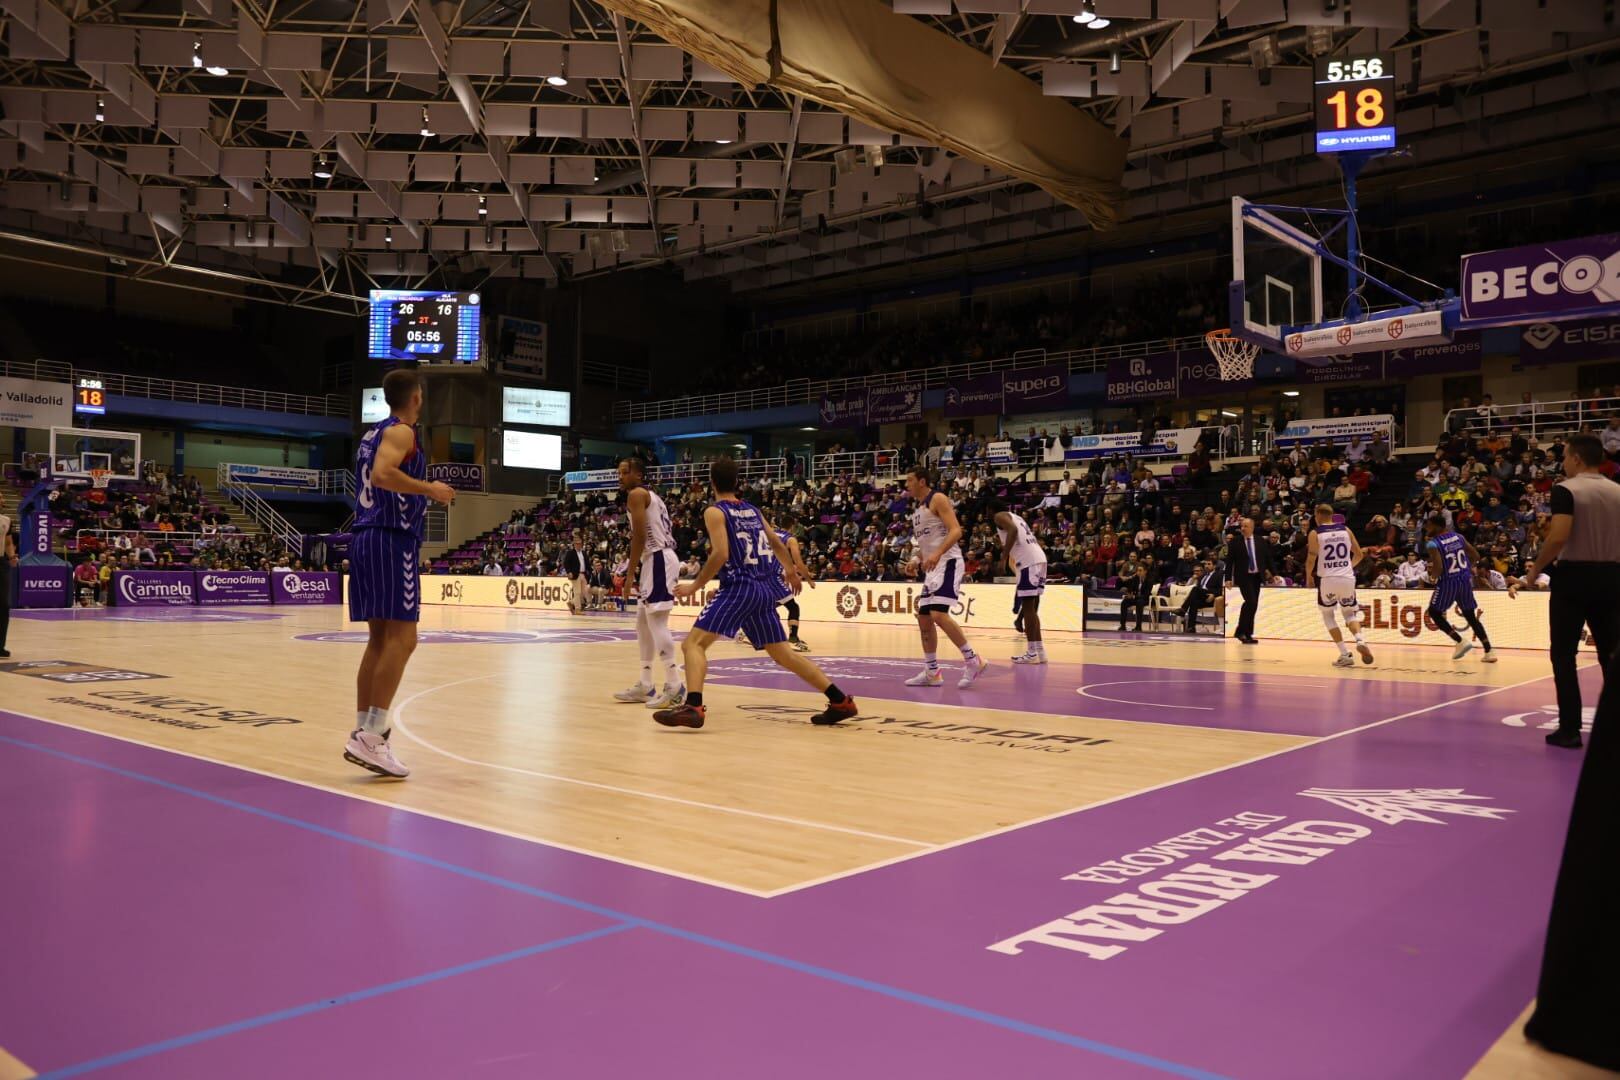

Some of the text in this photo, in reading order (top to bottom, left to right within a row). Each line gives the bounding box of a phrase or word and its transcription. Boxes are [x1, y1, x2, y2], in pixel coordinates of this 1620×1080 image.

[1327, 58, 1383, 81] 5:56
[1326, 88, 1384, 128] 18
[1340, 134, 1391, 144] HYUNDAI
[399, 303, 414, 315] 26
[437, 304, 452, 315] 16
[407, 331, 440, 342] 05:56
[408, 344, 416, 352] 4
[432, 344, 440, 353] 3
[1005, 375, 1061, 394] supera
[1108, 376, 1175, 395] RBHGlobal
[6, 391, 63, 406] Valladolid
[79, 389, 102, 406] 18
[38, 514, 48, 552] IVECO
[735, 529, 773, 564] 24
[1323, 542, 1348, 561] 20
[1323, 560, 1349, 569] IVECO
[1445, 549, 1468, 574] 20
[25, 580, 62, 588] IVECO
[520, 582, 561, 605] LaLiga
[1060, 810, 1288, 884] DE ZAMORA
[984, 819, 1372, 961] CAJA RURAL
